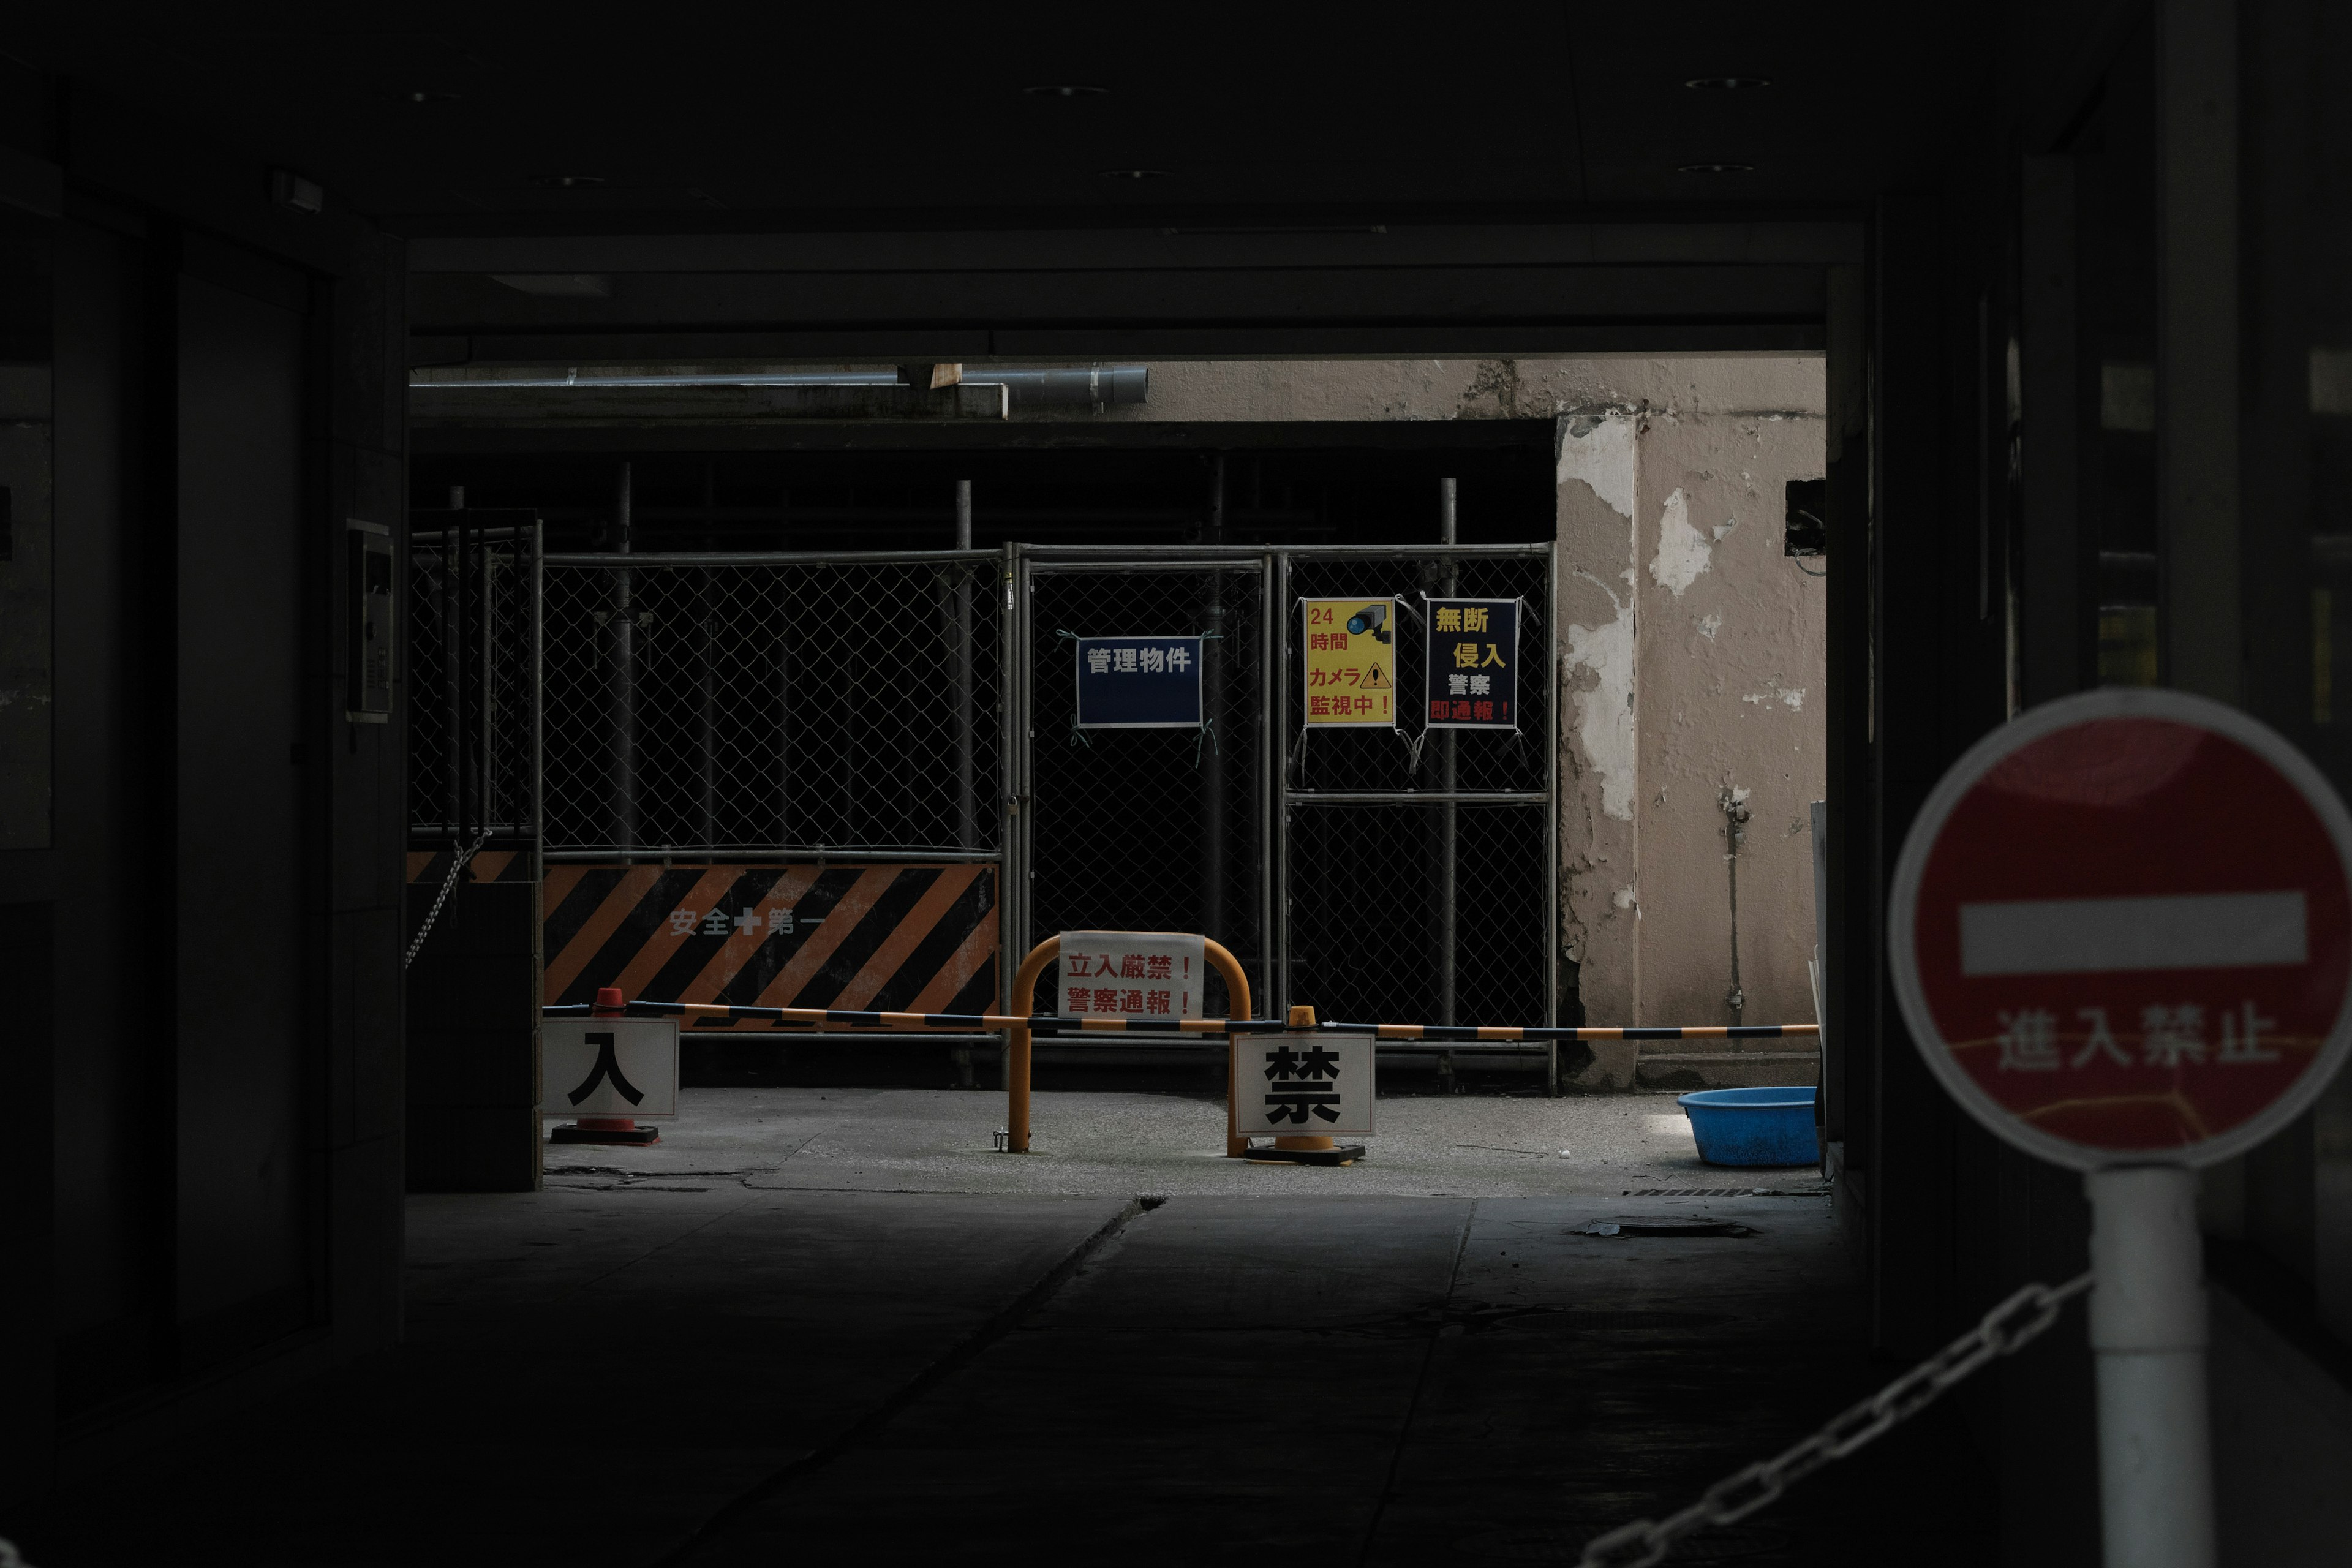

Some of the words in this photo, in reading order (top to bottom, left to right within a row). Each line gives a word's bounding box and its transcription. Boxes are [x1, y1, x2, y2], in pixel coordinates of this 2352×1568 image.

[1311, 608, 1333, 625] 24
[1436, 607, 1489, 633] 無断
[1310, 633, 1348, 651] 時間
[1087, 647, 1191, 674] 管理物件
[1453, 643, 1507, 668] 侵入
[1310, 668, 1361, 687] カメラ
[1448, 674, 1490, 696] 警察
[1310, 695, 1388, 716] 監視中！
[1430, 700, 1508, 720] 即通報！
[1067, 953, 1189, 980] 立入厳禁！
[1067, 987, 1188, 1014] 警察通報！
[1997, 1000, 2281, 1072] 進入禁止
[567, 1032, 645, 1107] 入
[1264, 1046, 1341, 1125] 禁
